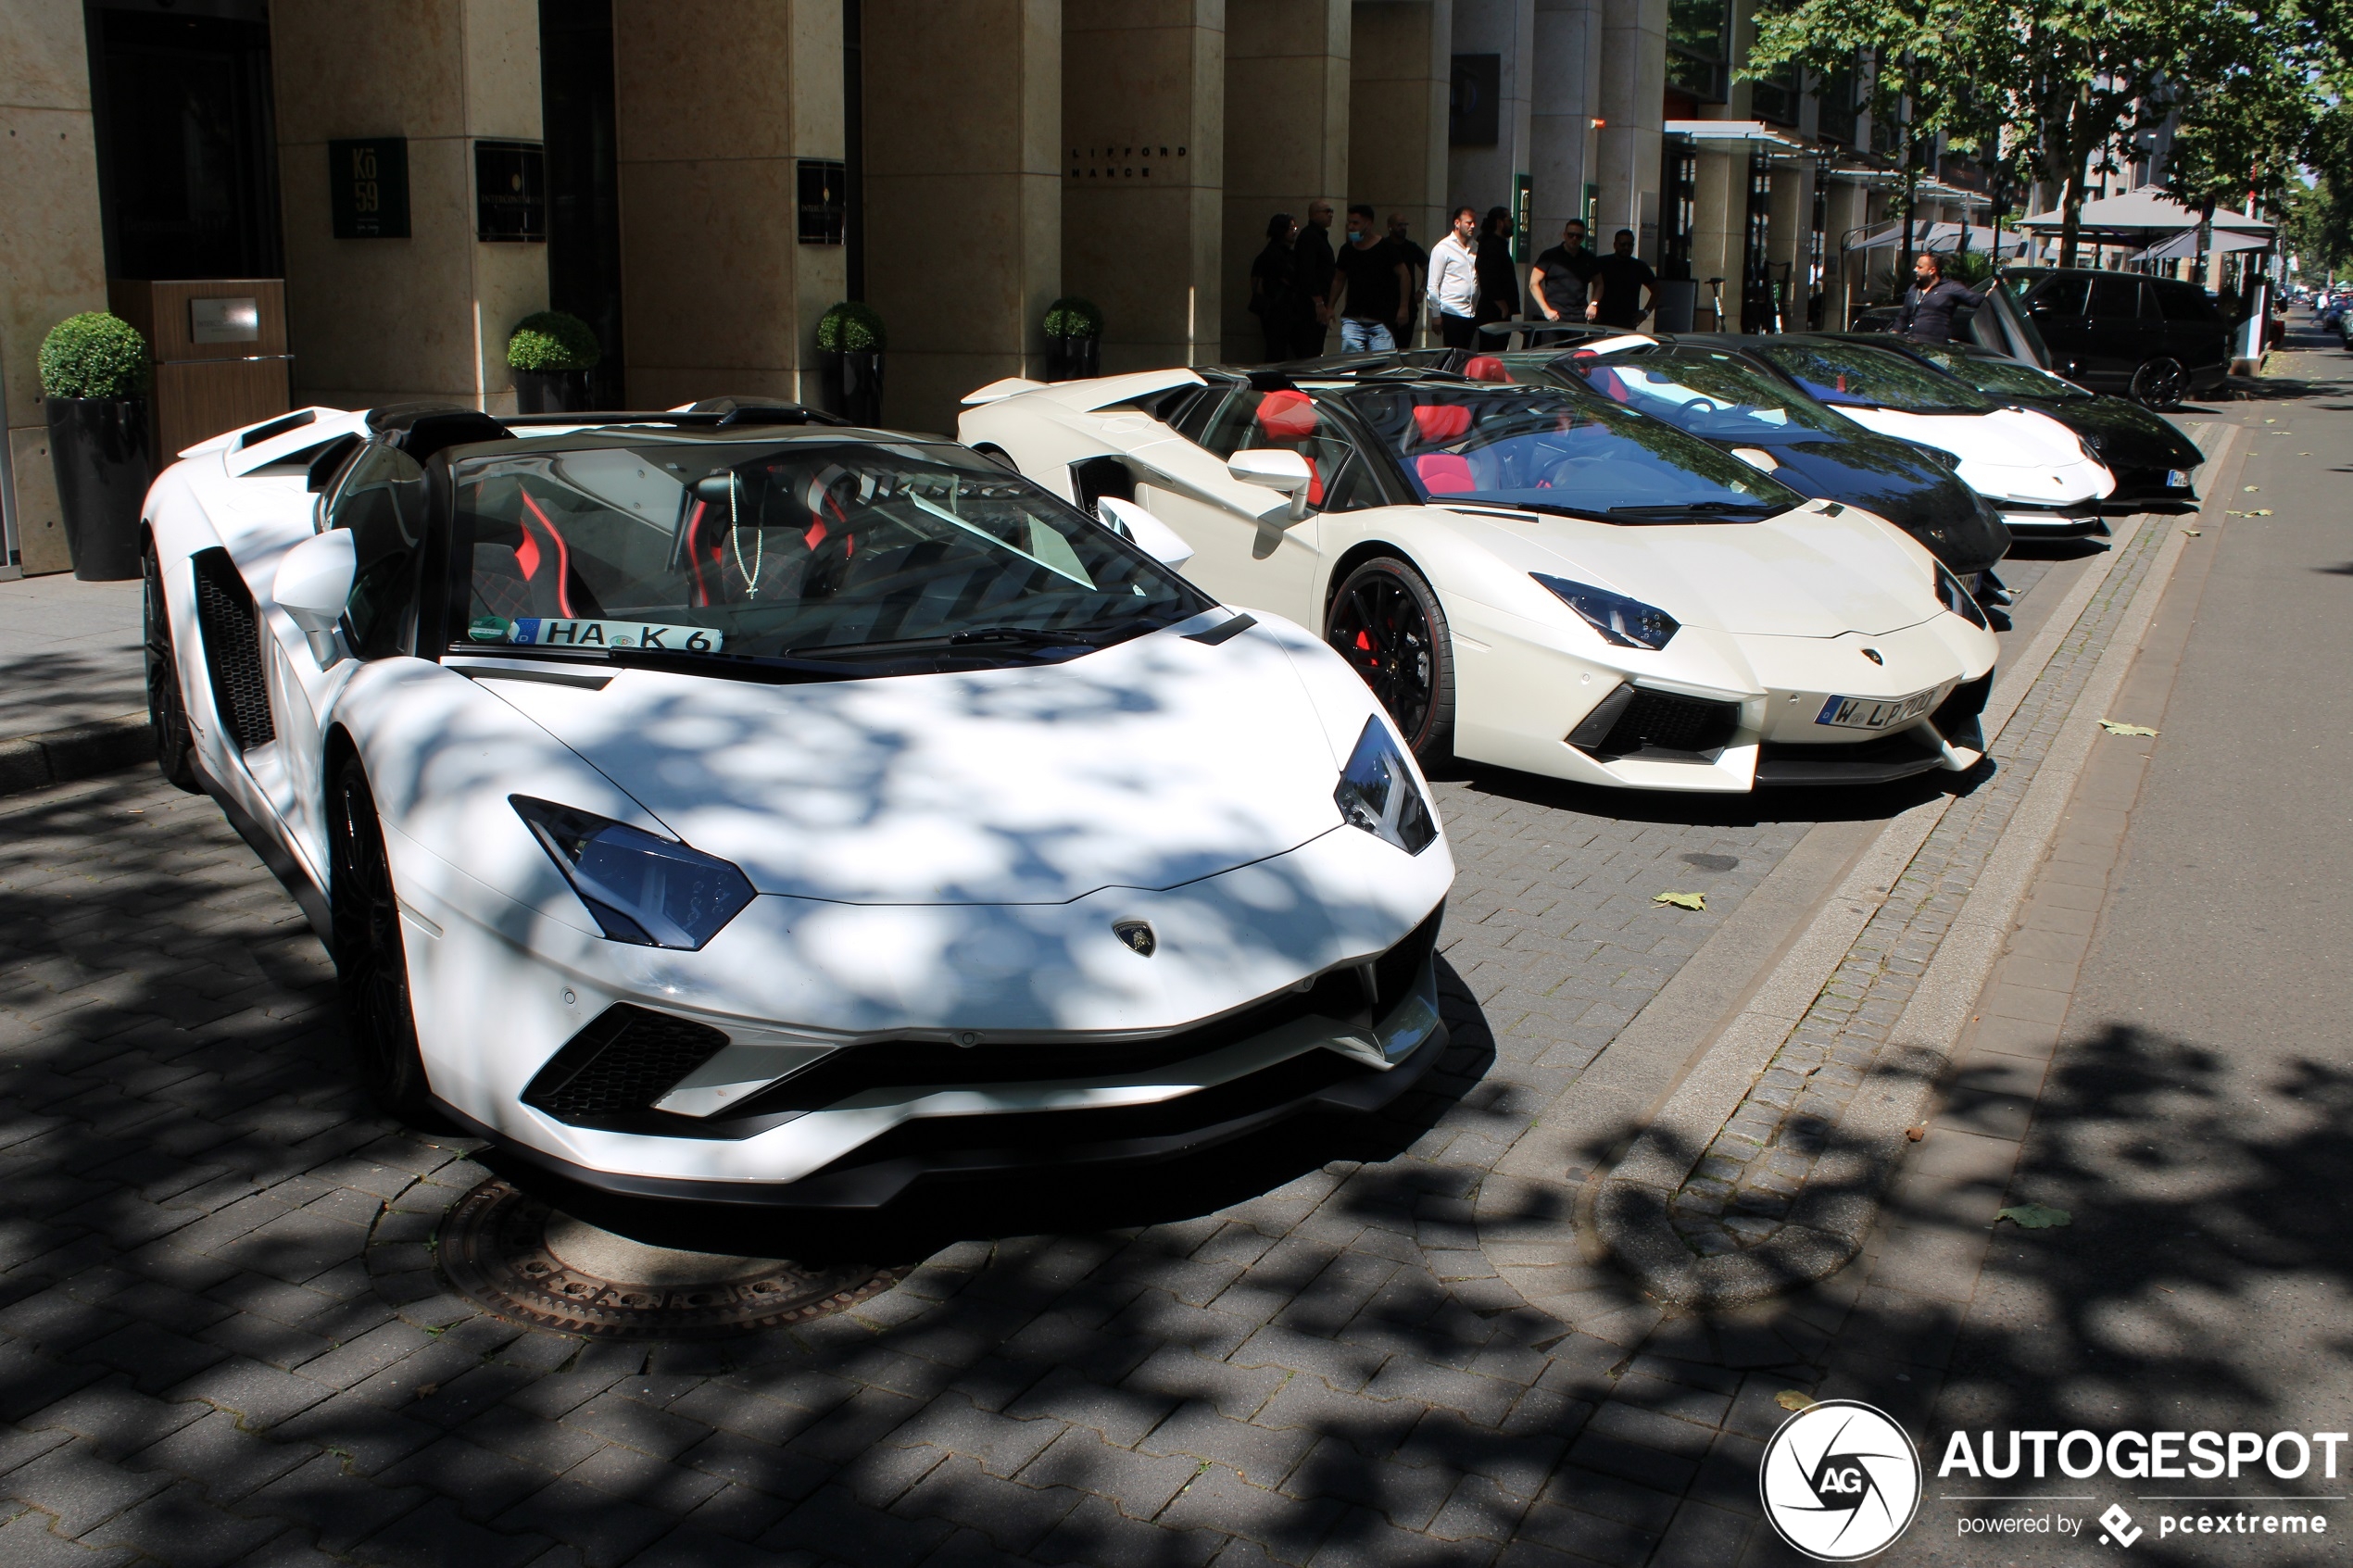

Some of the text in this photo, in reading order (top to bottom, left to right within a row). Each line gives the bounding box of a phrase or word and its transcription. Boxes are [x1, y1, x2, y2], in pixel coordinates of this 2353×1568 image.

[355, 182, 379, 212] 59
[546, 621, 605, 646] HA
[640, 626, 669, 648] K
[686, 630, 711, 652] 6
[1835, 700, 1859, 722] W
